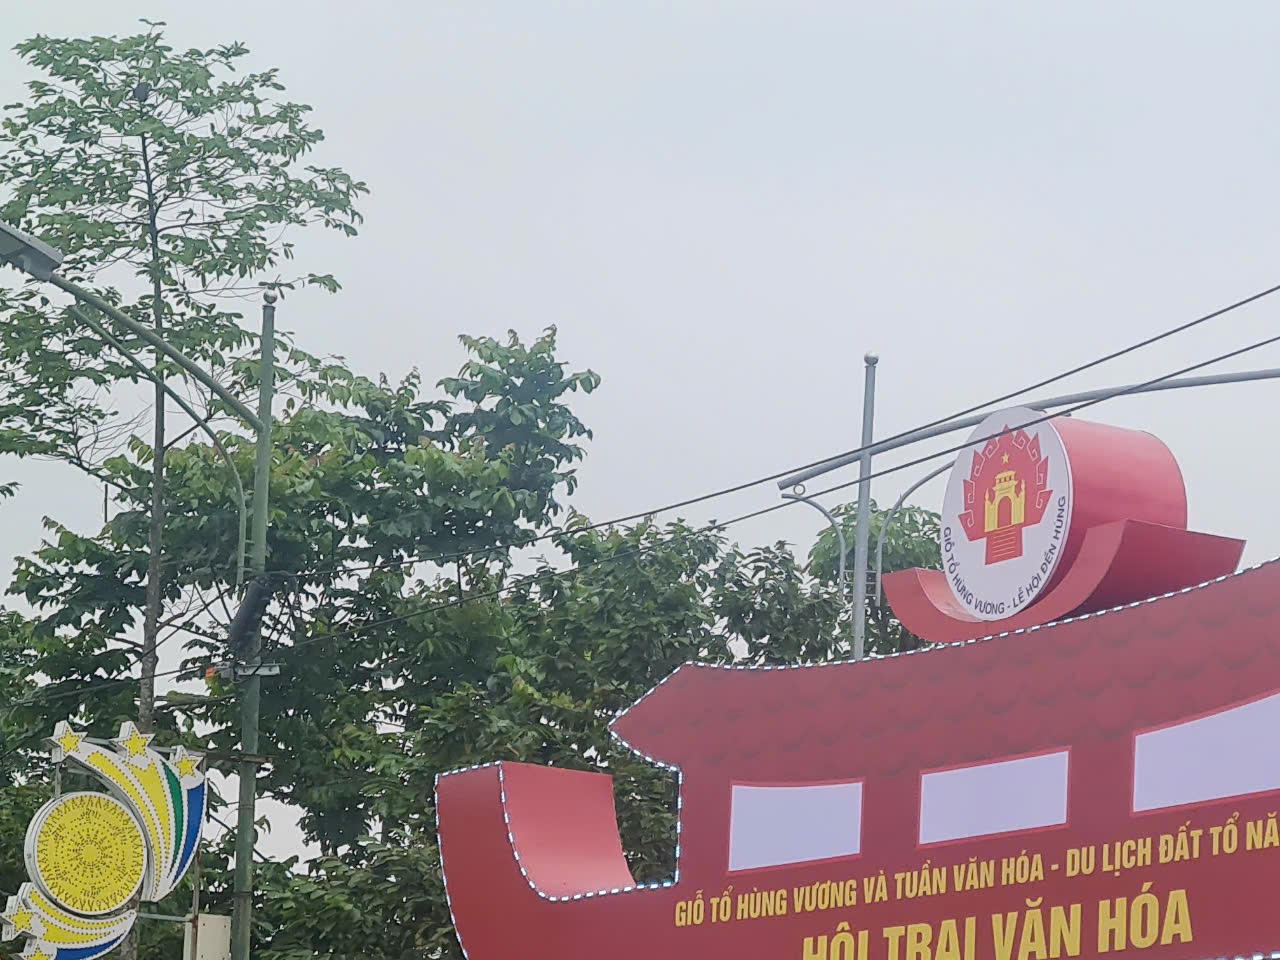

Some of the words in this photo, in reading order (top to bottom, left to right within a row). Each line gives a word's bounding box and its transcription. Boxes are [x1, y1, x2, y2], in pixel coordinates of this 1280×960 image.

[1025, 573, 1042, 597] HỘI
[675, 889, 705, 927] GIỖ
[710, 885, 734, 923] TỔ
[736, 887, 788, 920] HÙNG
[793, 879, 857, 913] VƯƠNG
[863, 869, 888, 904] VÀ
[894, 859, 947, 899] TUẦN
[953, 856, 995, 891] VĂN
[1001, 849, 1044, 886] HÓA
[1066, 845, 1095, 877] DU
[1102, 837, 1152, 877] LỊCH
[1158, 820, 1203, 864] ĐẤT
[1209, 812, 1240, 856] TỔ
[1097, 881, 1193, 953] HÓA
